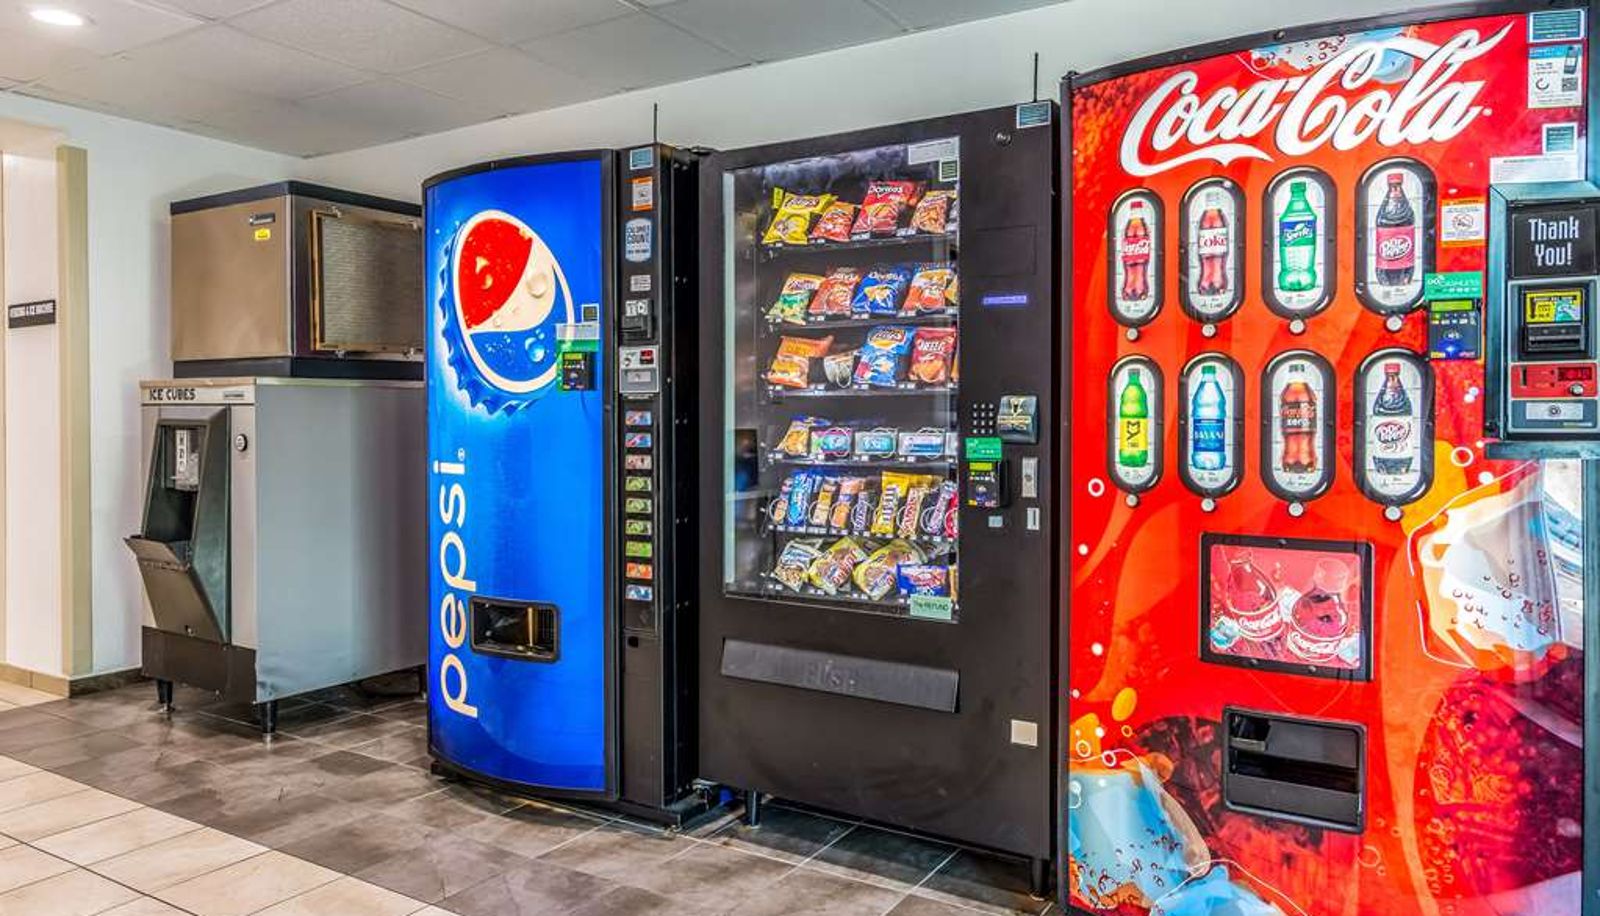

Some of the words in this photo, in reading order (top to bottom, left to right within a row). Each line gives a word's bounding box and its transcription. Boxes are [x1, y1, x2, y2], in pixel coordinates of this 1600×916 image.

[1120, 21, 1514, 176] Coca-Cola
[1528, 215, 1580, 241] Thank
[1534, 242, 1573, 267] You!
[149, 387, 163, 400] ICE
[433, 459, 478, 718] pepsi
